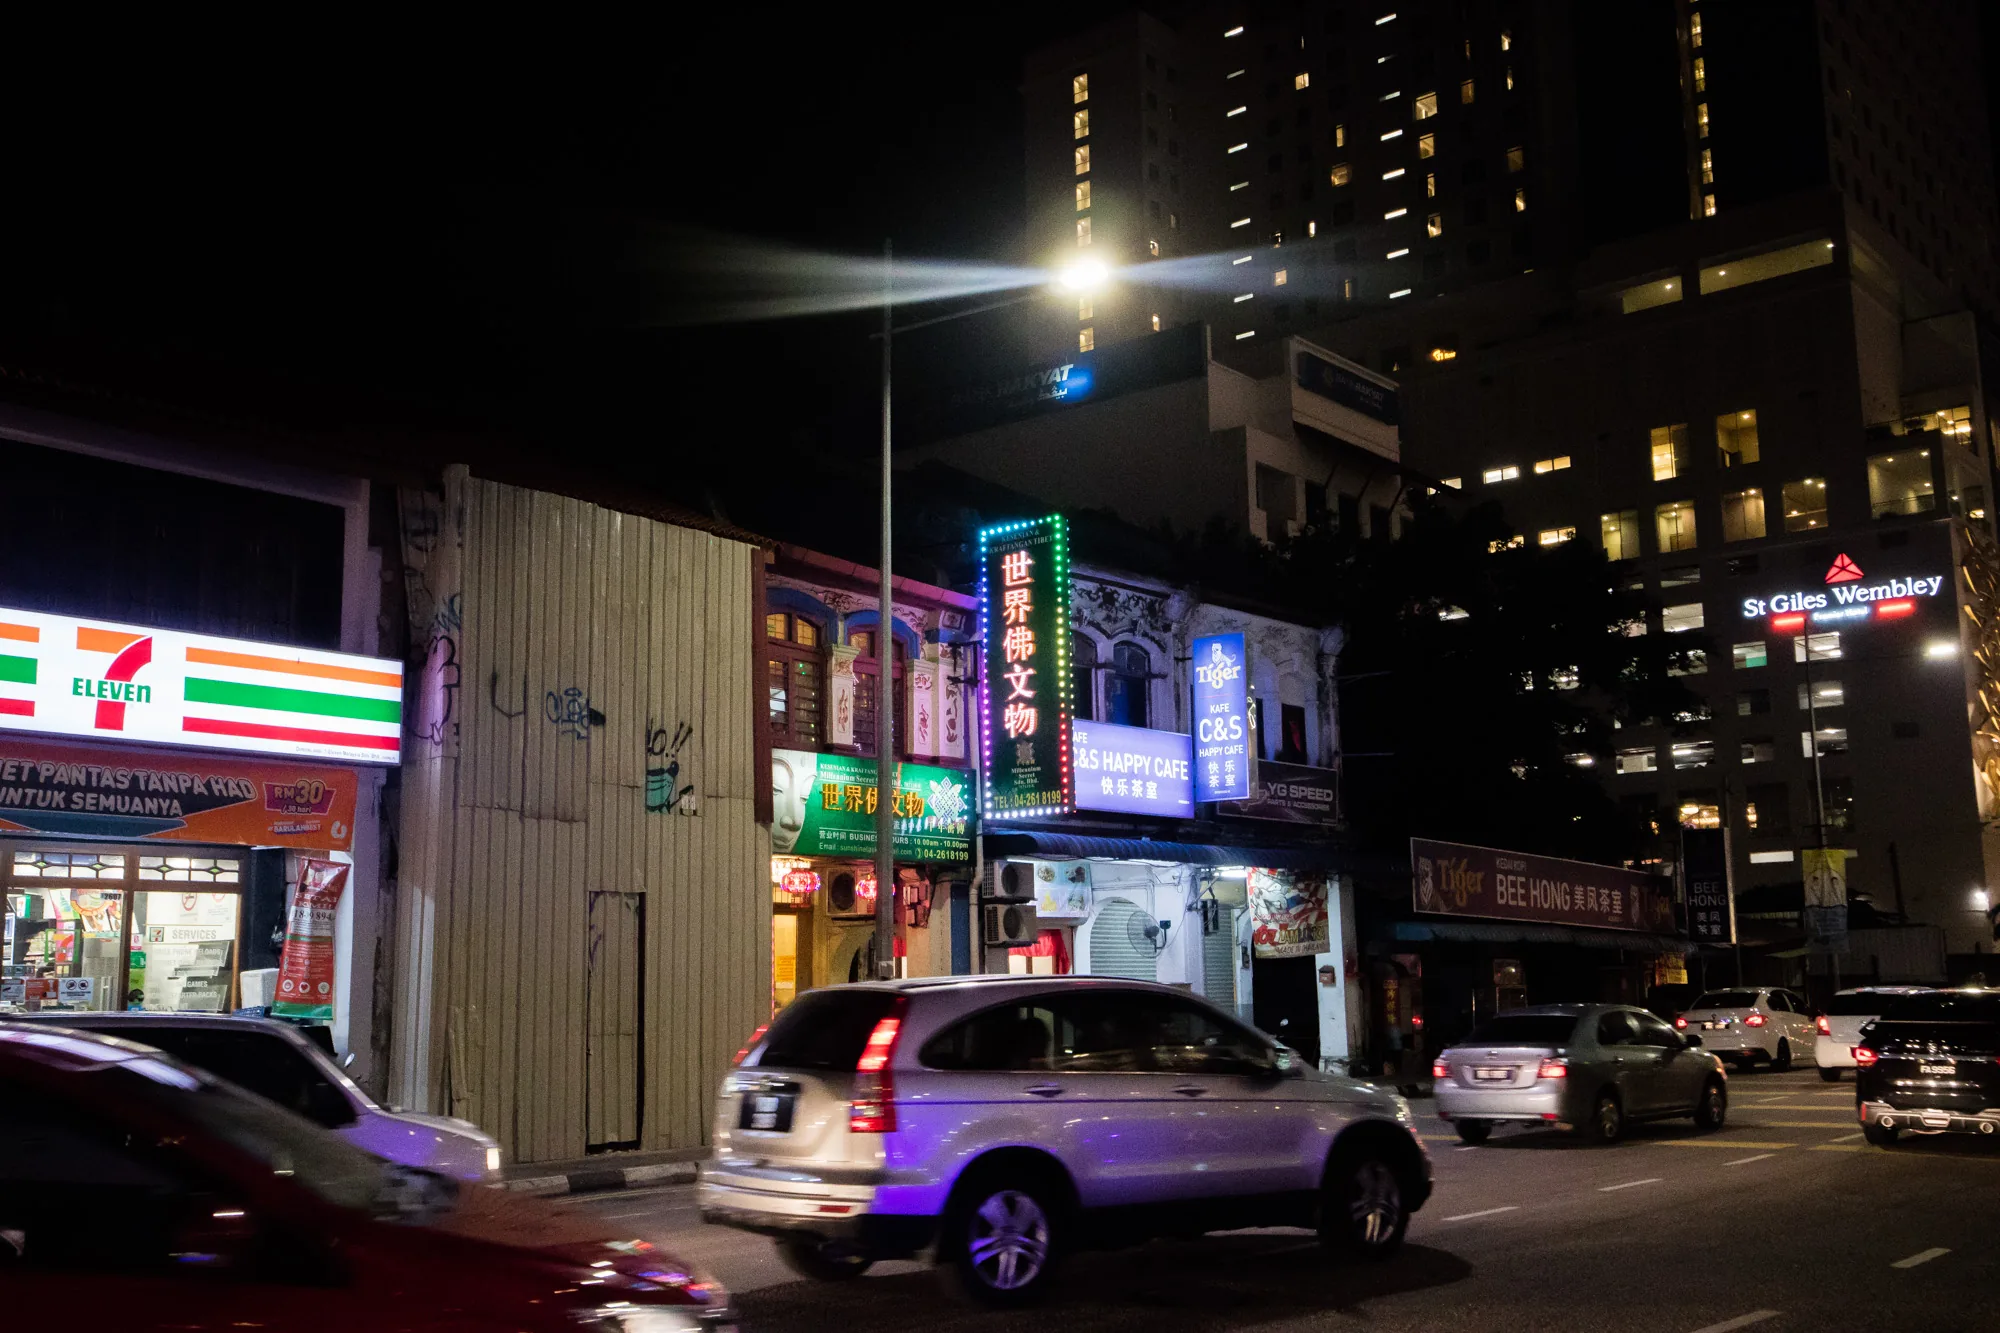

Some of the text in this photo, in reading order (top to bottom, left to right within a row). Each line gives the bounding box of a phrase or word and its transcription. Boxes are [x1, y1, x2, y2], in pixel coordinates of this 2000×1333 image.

[1743, 575, 1943, 617] St Giles Wembley
[1001, 550, 1039, 738] 世界佛文物
[76, 626, 153, 731] 7
[1196, 661, 1241, 690] Tiger
[1210, 703, 1230, 714] KAFE
[1072, 731, 1088, 743] AFE
[1199, 715, 1243, 743] C&S
[1199, 744, 1244, 758] HAPPY CAFE
[1103, 750, 1151, 776] HAPPY
[1154, 757, 1189, 780] CAFE
[1208, 760, 1236, 774] 快乐
[38, 761, 130, 791] PANTAS
[133, 771, 208, 797] TANPA
[210, 777, 256, 801] HAD
[1101, 775, 1158, 800] 快乐茶室
[1209, 774, 1236, 788] 茶室
[1267, 782, 1333, 802] YG SPEED
[70, 791, 183, 818] SEMUANYA
[924, 848, 969, 860] 04-2618199
[1437, 857, 1485, 907] Tiger
[1496, 873, 1527, 907] BEE
[1529, 877, 1570, 912] HONG
[1693, 881, 1719, 894] BEE
[1688, 894, 1726, 907] HONG
[172, 929, 217, 940] SERVICES
